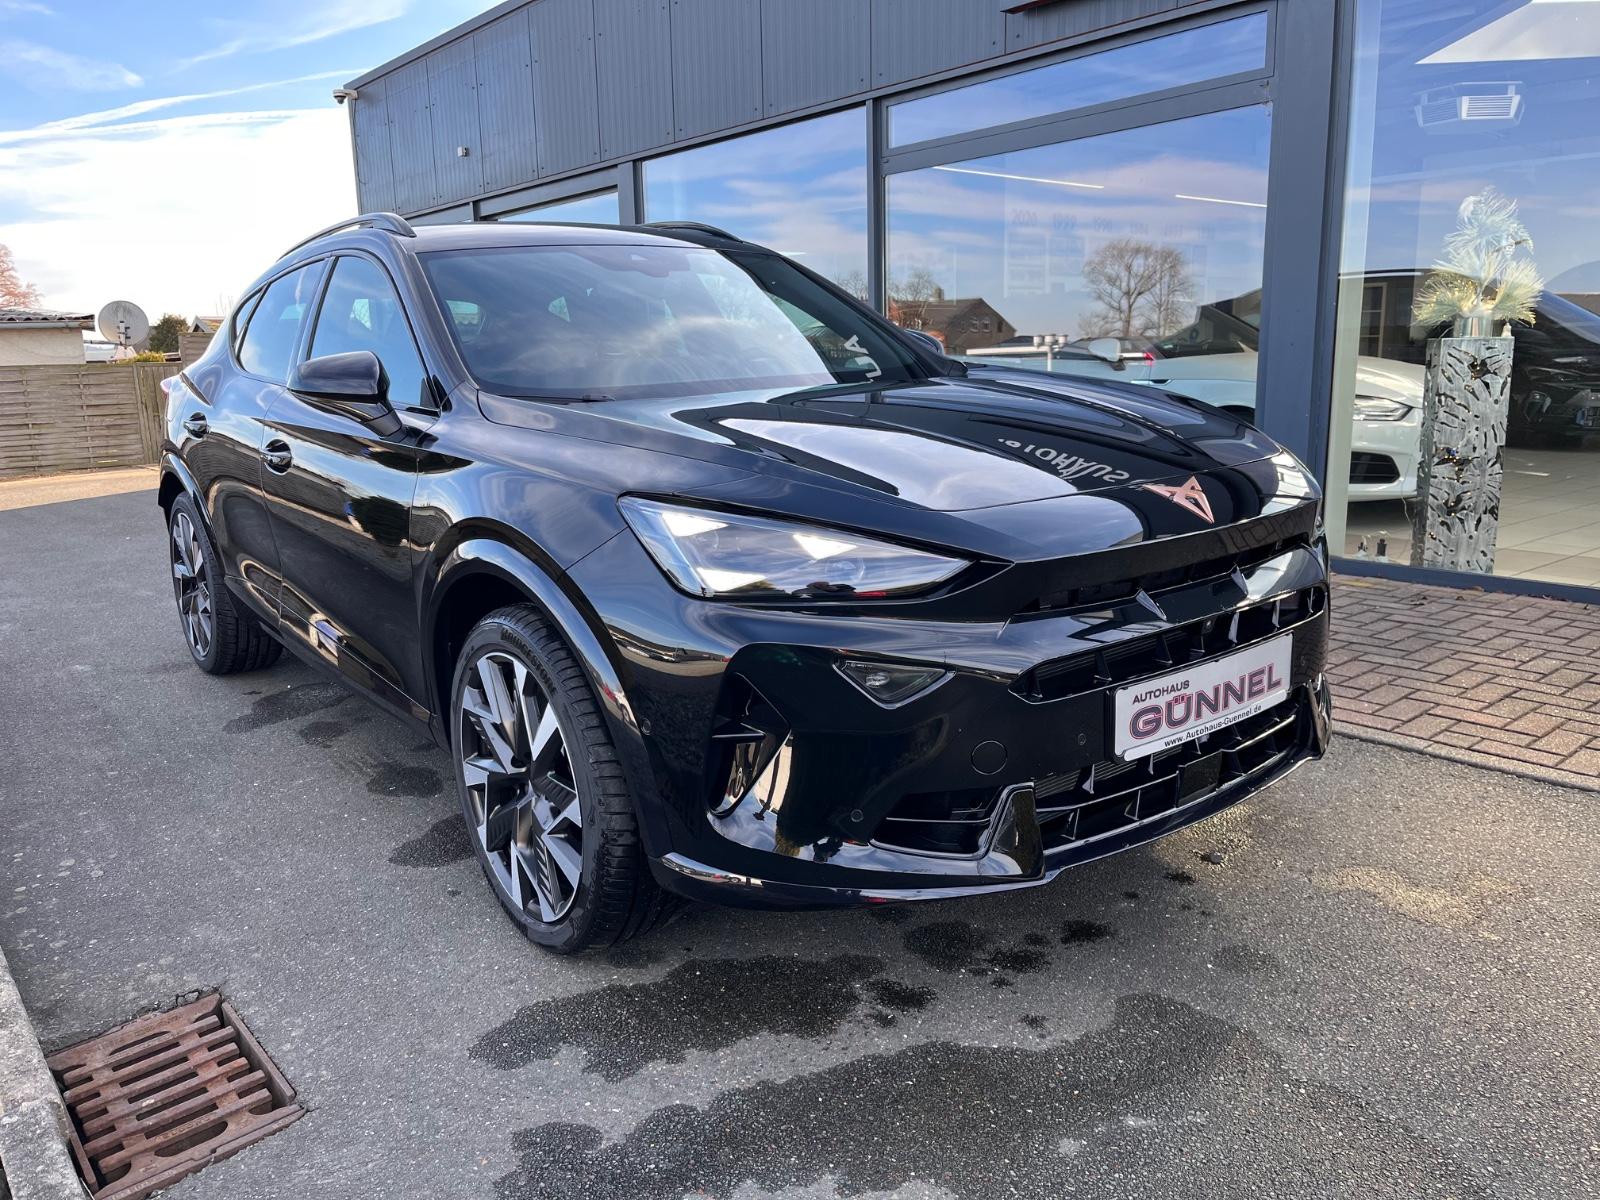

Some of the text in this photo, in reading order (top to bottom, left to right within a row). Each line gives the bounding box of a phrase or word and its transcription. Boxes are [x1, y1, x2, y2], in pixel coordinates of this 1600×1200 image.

[1129, 663, 1282, 740] GÜNNEL
[1132, 680, 1190, 704] AUTOHAUS
[1164, 705, 1262, 748] www.Autohaus-Guennel.de
